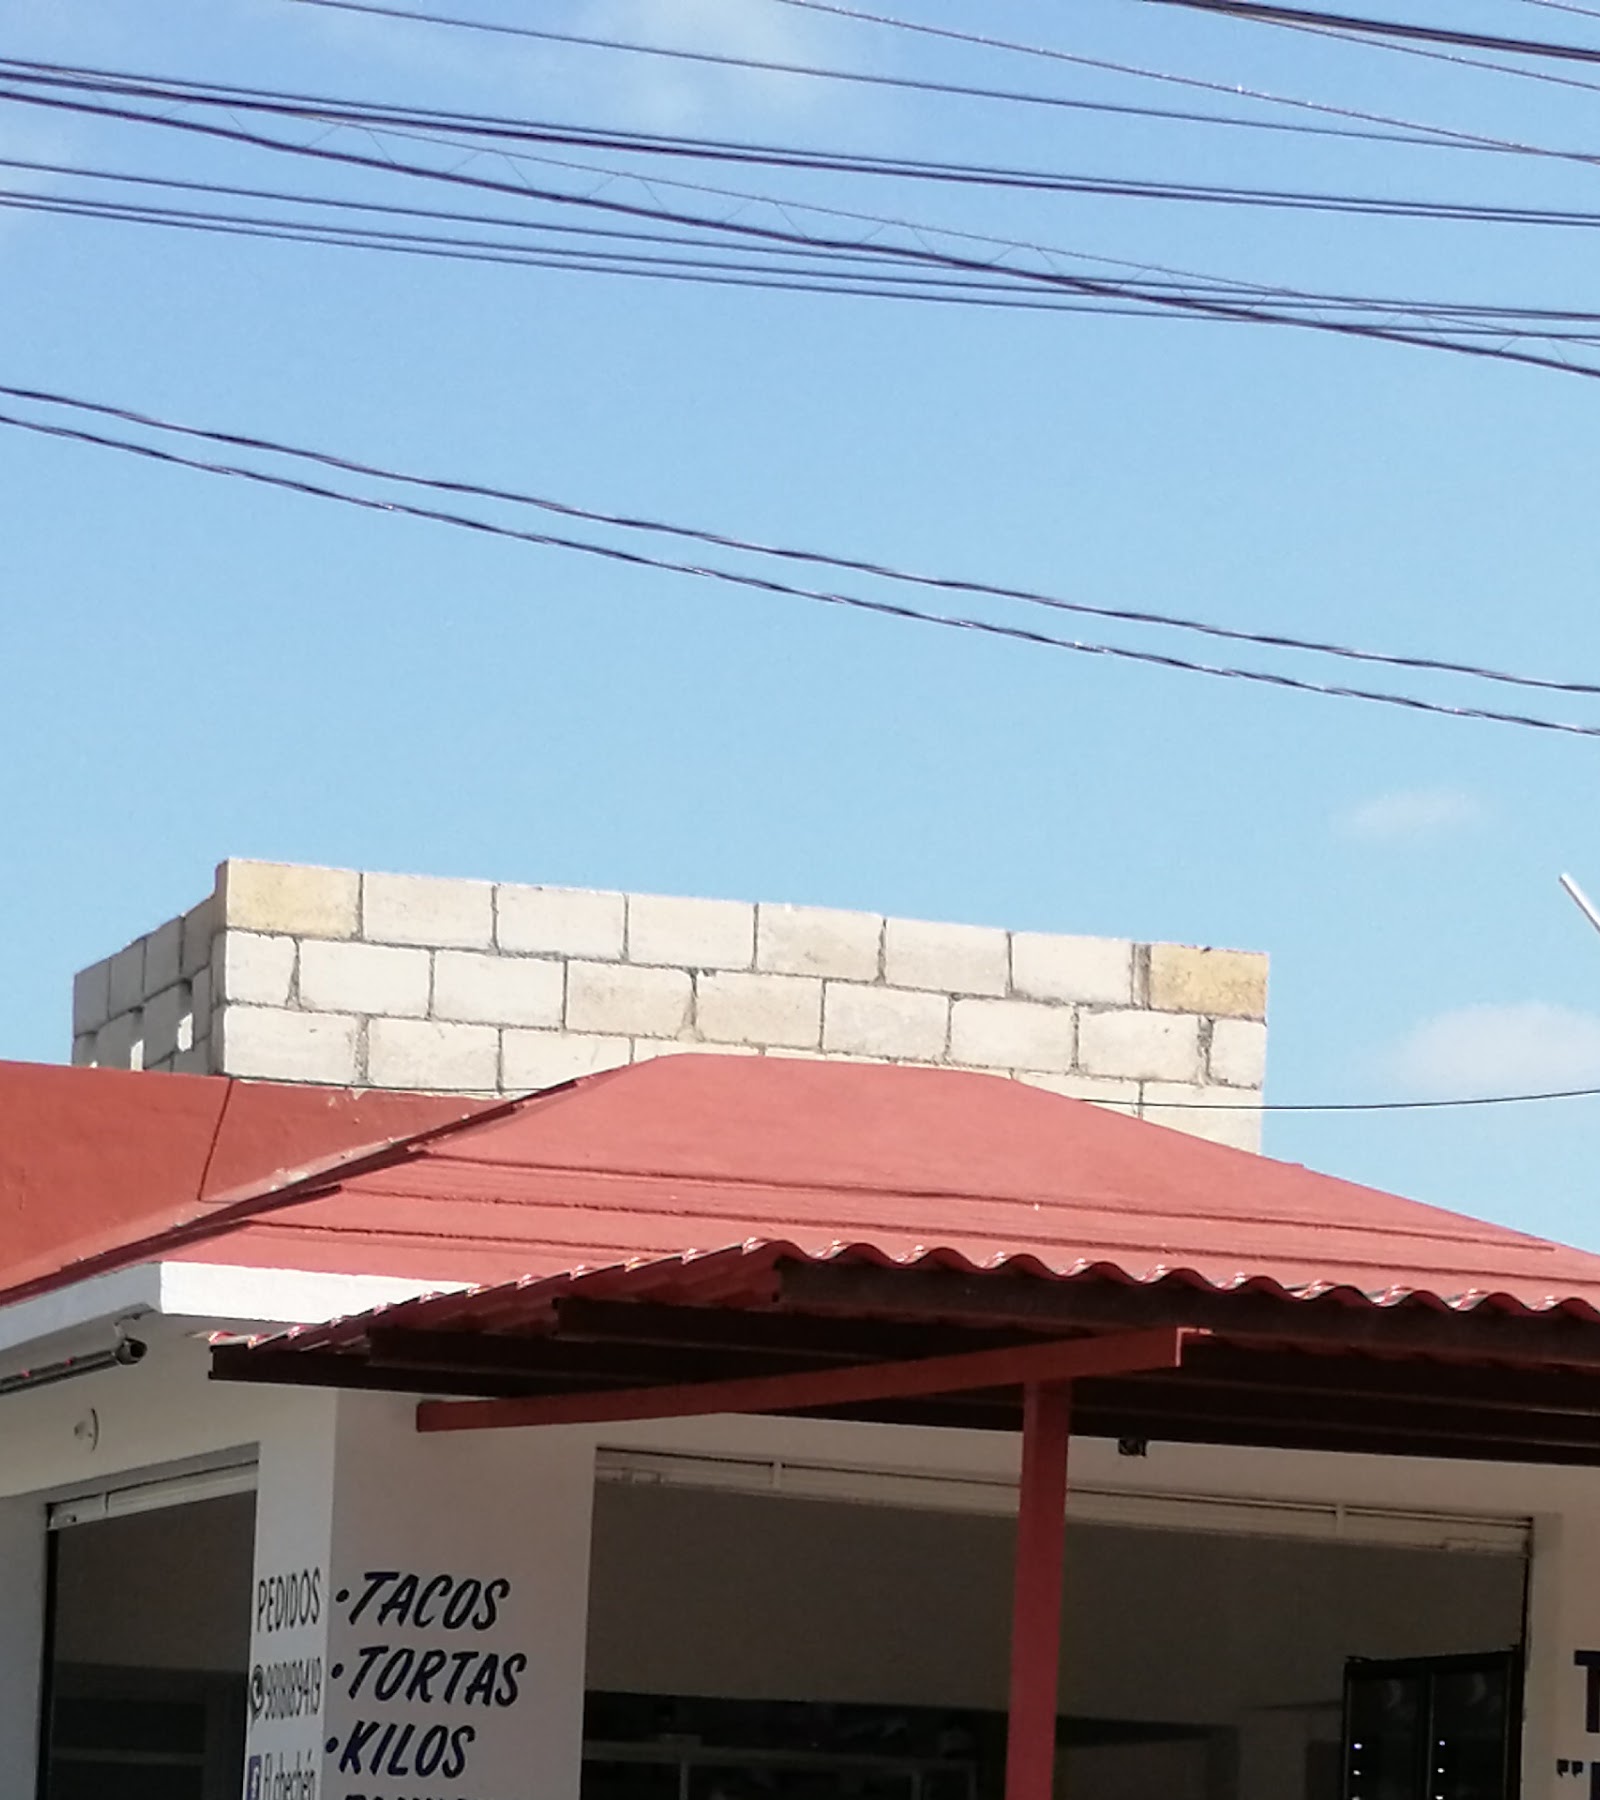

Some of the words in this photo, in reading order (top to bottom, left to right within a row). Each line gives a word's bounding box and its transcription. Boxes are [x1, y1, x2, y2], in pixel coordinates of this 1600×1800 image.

[256, 1567, 321, 1633] PEDIDOS
[348, 1571, 510, 1630] TACOS
[347, 1645, 527, 1708] TORTAS
[339, 1721, 476, 1779] KILOS
